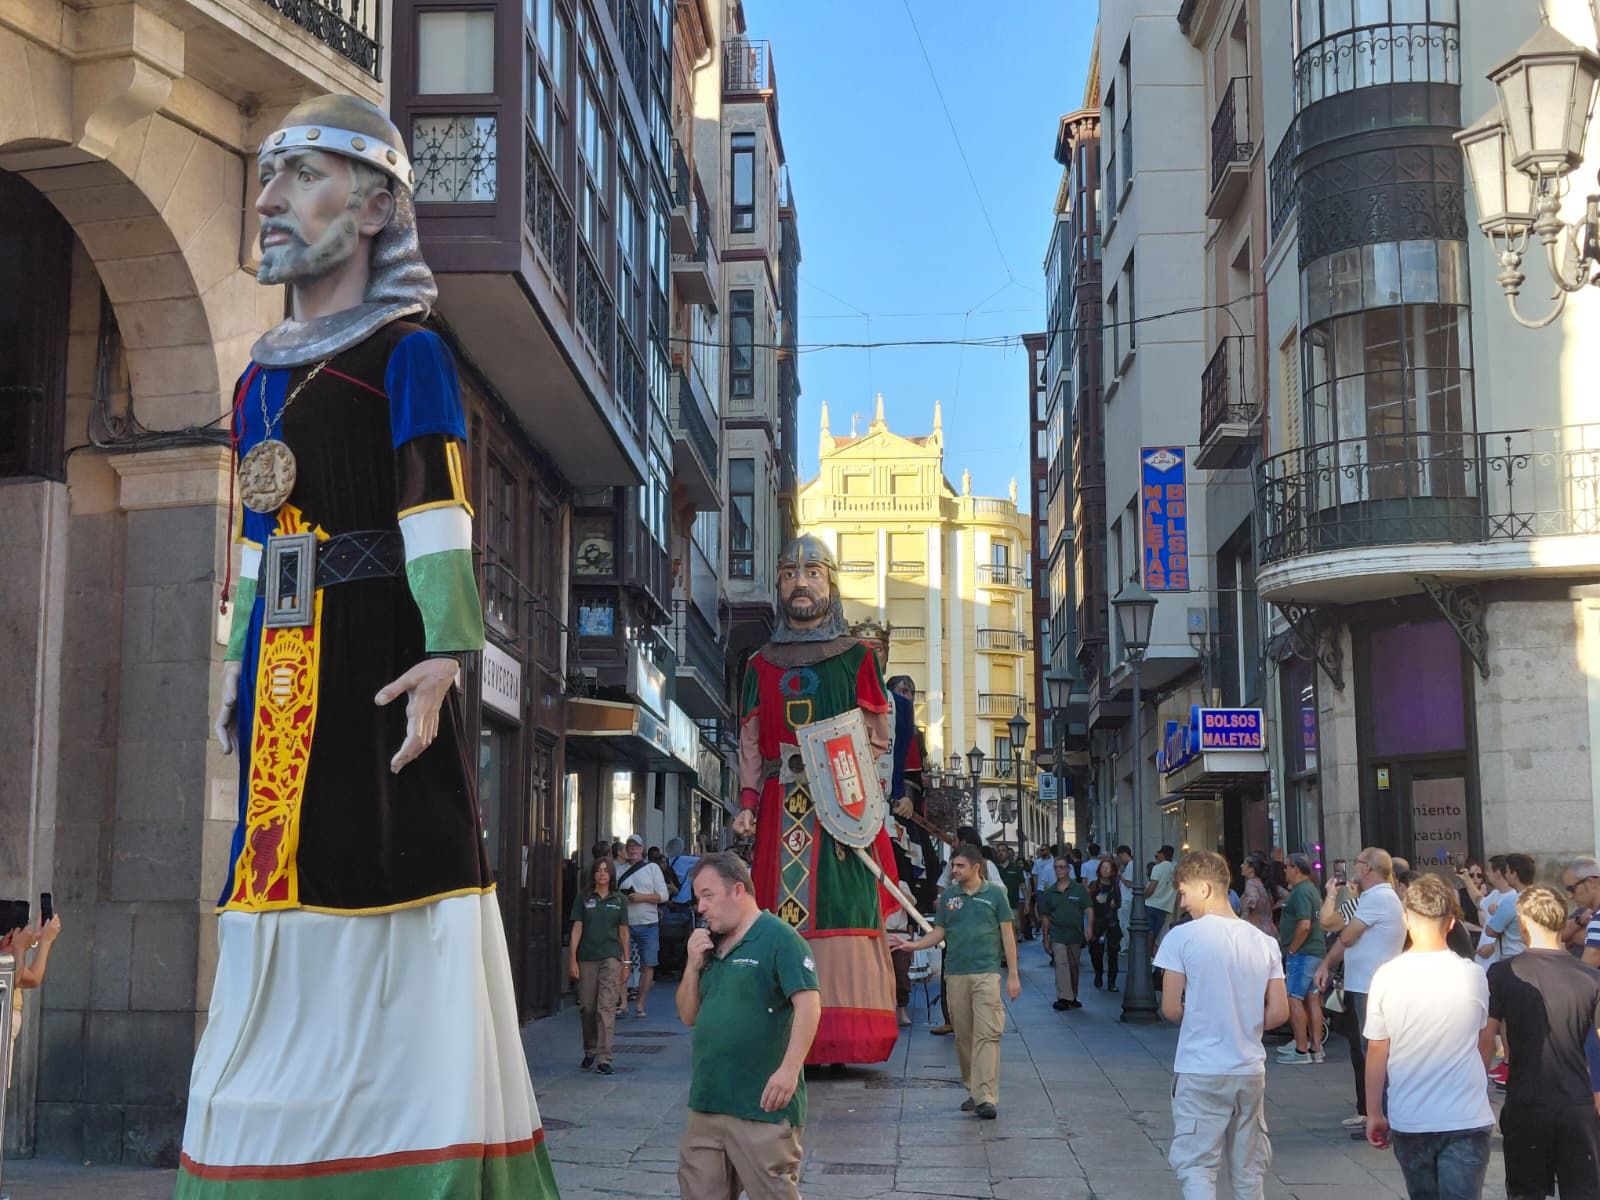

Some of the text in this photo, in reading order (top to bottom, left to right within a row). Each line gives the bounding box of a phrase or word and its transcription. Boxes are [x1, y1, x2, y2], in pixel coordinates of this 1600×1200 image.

[1145, 485, 1165, 588] MALETAS
[1167, 485, 1187, 588] BOLSOS
[1203, 732, 1260, 746] MALETAS
[1205, 714, 1256, 728] BOLSOS
